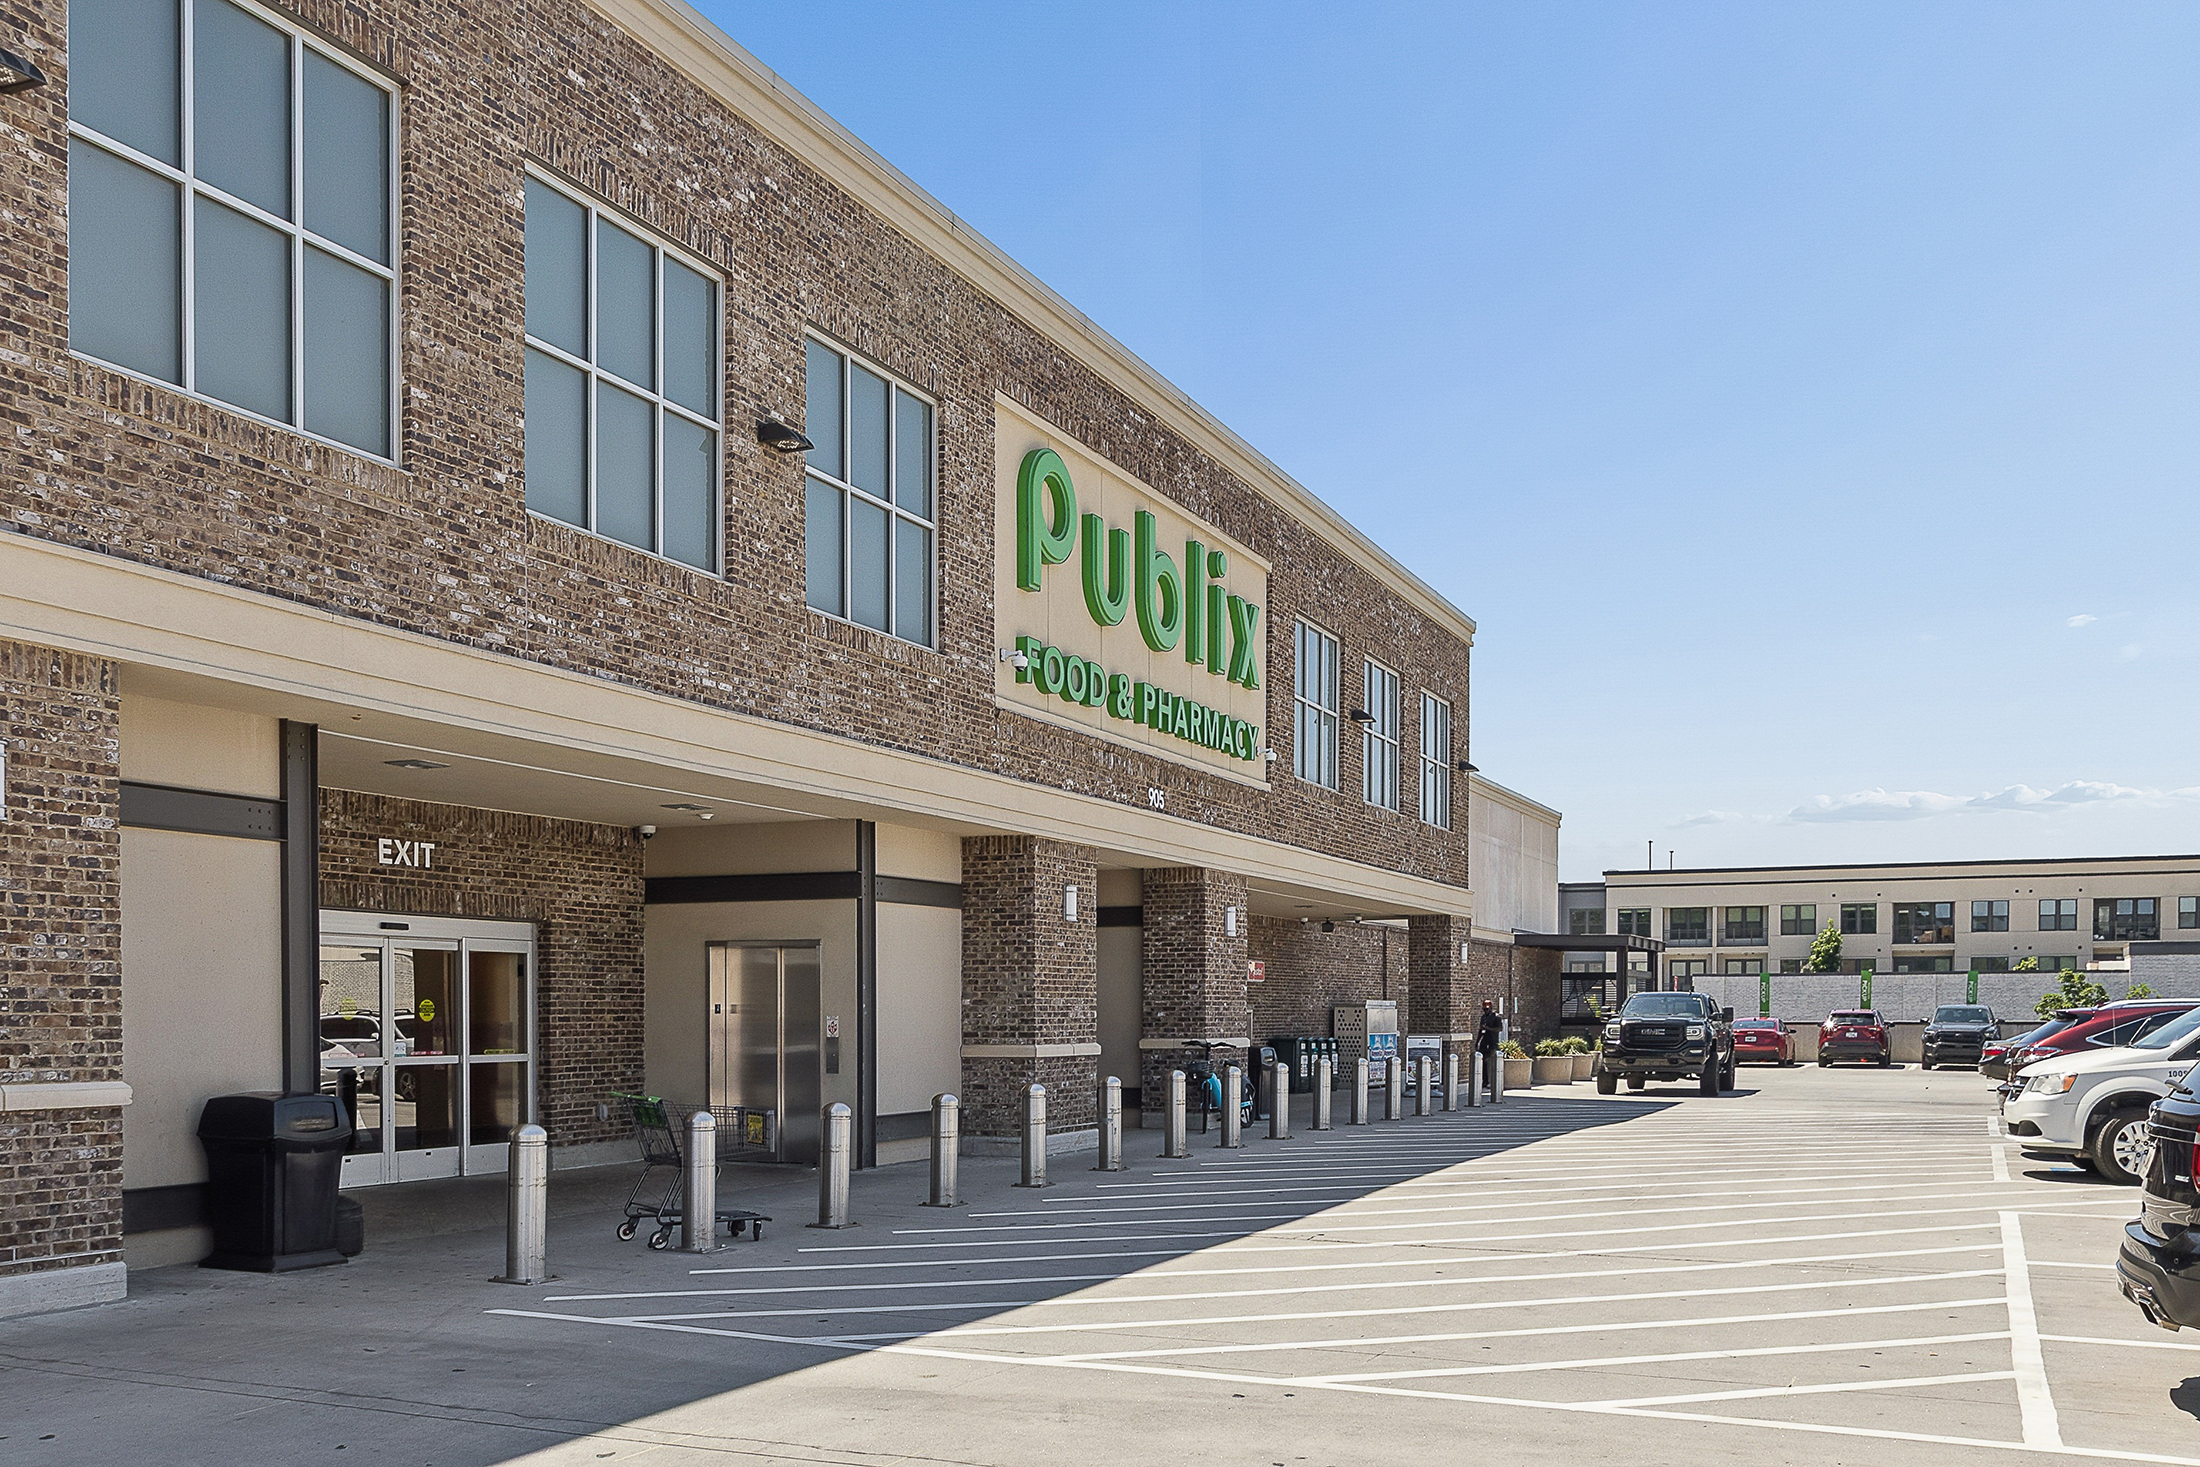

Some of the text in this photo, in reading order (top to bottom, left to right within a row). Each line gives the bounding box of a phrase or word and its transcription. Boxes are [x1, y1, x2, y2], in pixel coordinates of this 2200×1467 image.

[1017, 448, 1259, 690] Publix
[1016, 636, 1259, 761] FOOD & PHARMACY
[1148, 787, 1165, 809] 905
[379, 838, 435, 868] EXIT
